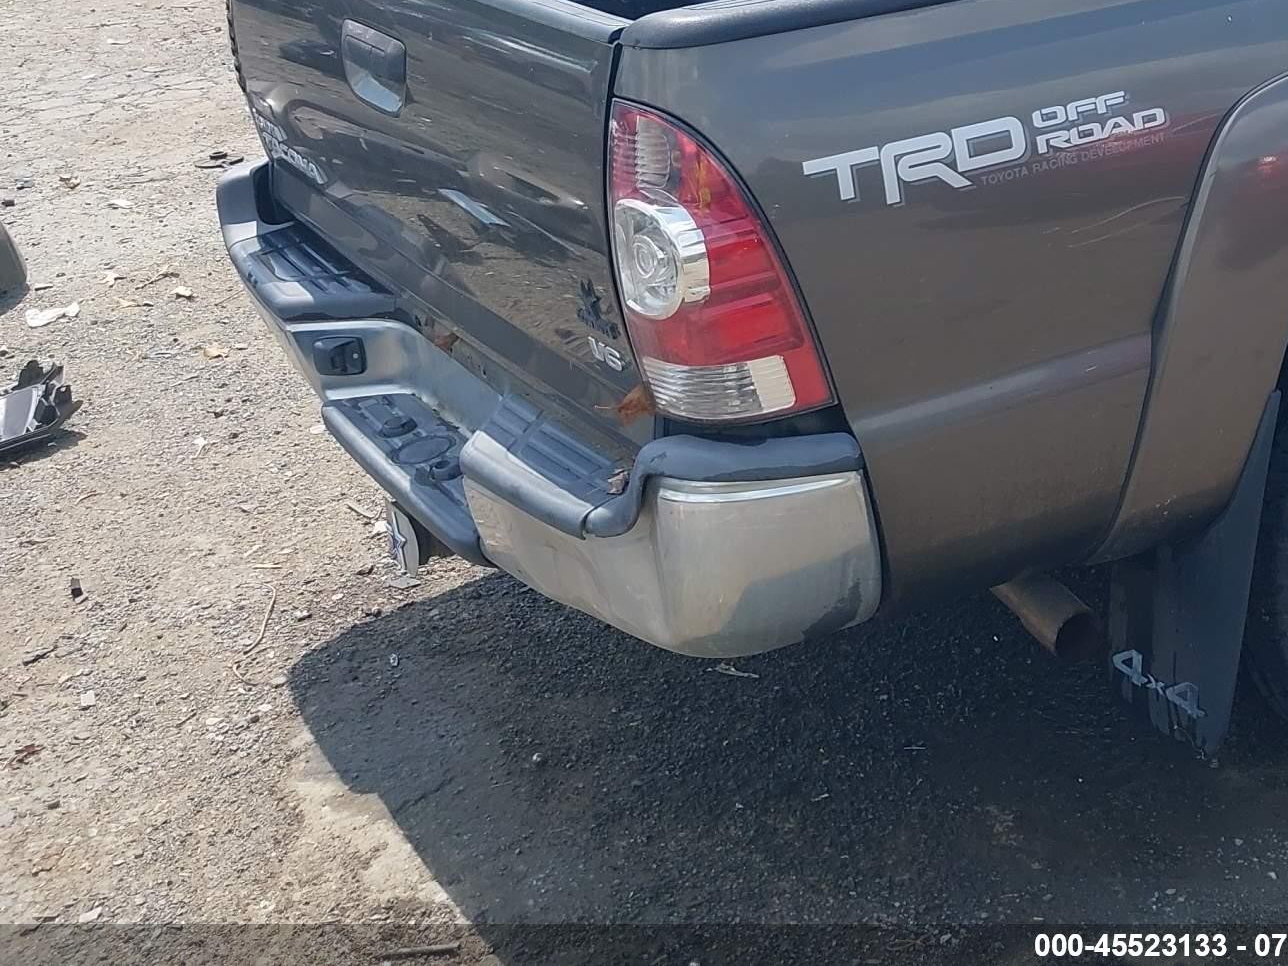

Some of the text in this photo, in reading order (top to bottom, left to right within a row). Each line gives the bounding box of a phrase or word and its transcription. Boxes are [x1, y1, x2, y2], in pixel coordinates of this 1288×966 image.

[1032, 90, 1126, 129] OFF
[1035, 107, 1168, 155] ROAD
[802, 116, 1027, 206] TRD
[980, 131, 1168, 186] TOYOTA RACING DEVELOPMENT
[588, 336, 624, 372] V6
